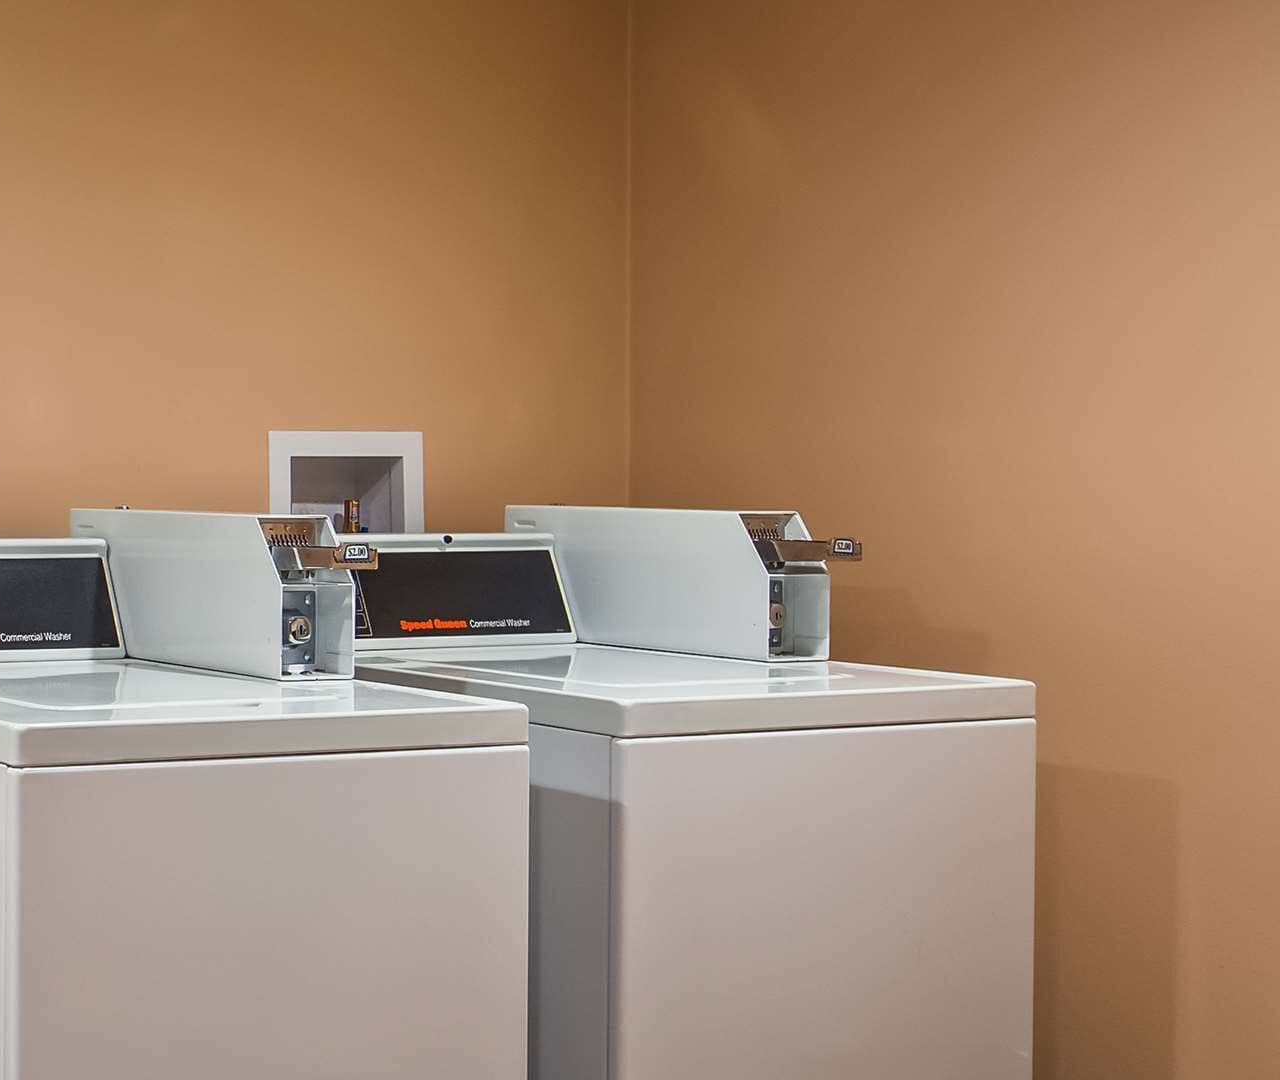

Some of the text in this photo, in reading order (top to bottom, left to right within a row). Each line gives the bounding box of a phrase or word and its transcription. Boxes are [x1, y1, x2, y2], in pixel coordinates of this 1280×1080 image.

[347, 547, 367, 557] $2.00
[400, 618, 531, 632] Speed Queen Commercial Washer
[0, 632, 43, 642] Commercial
[43, 632, 72, 641] Washer
